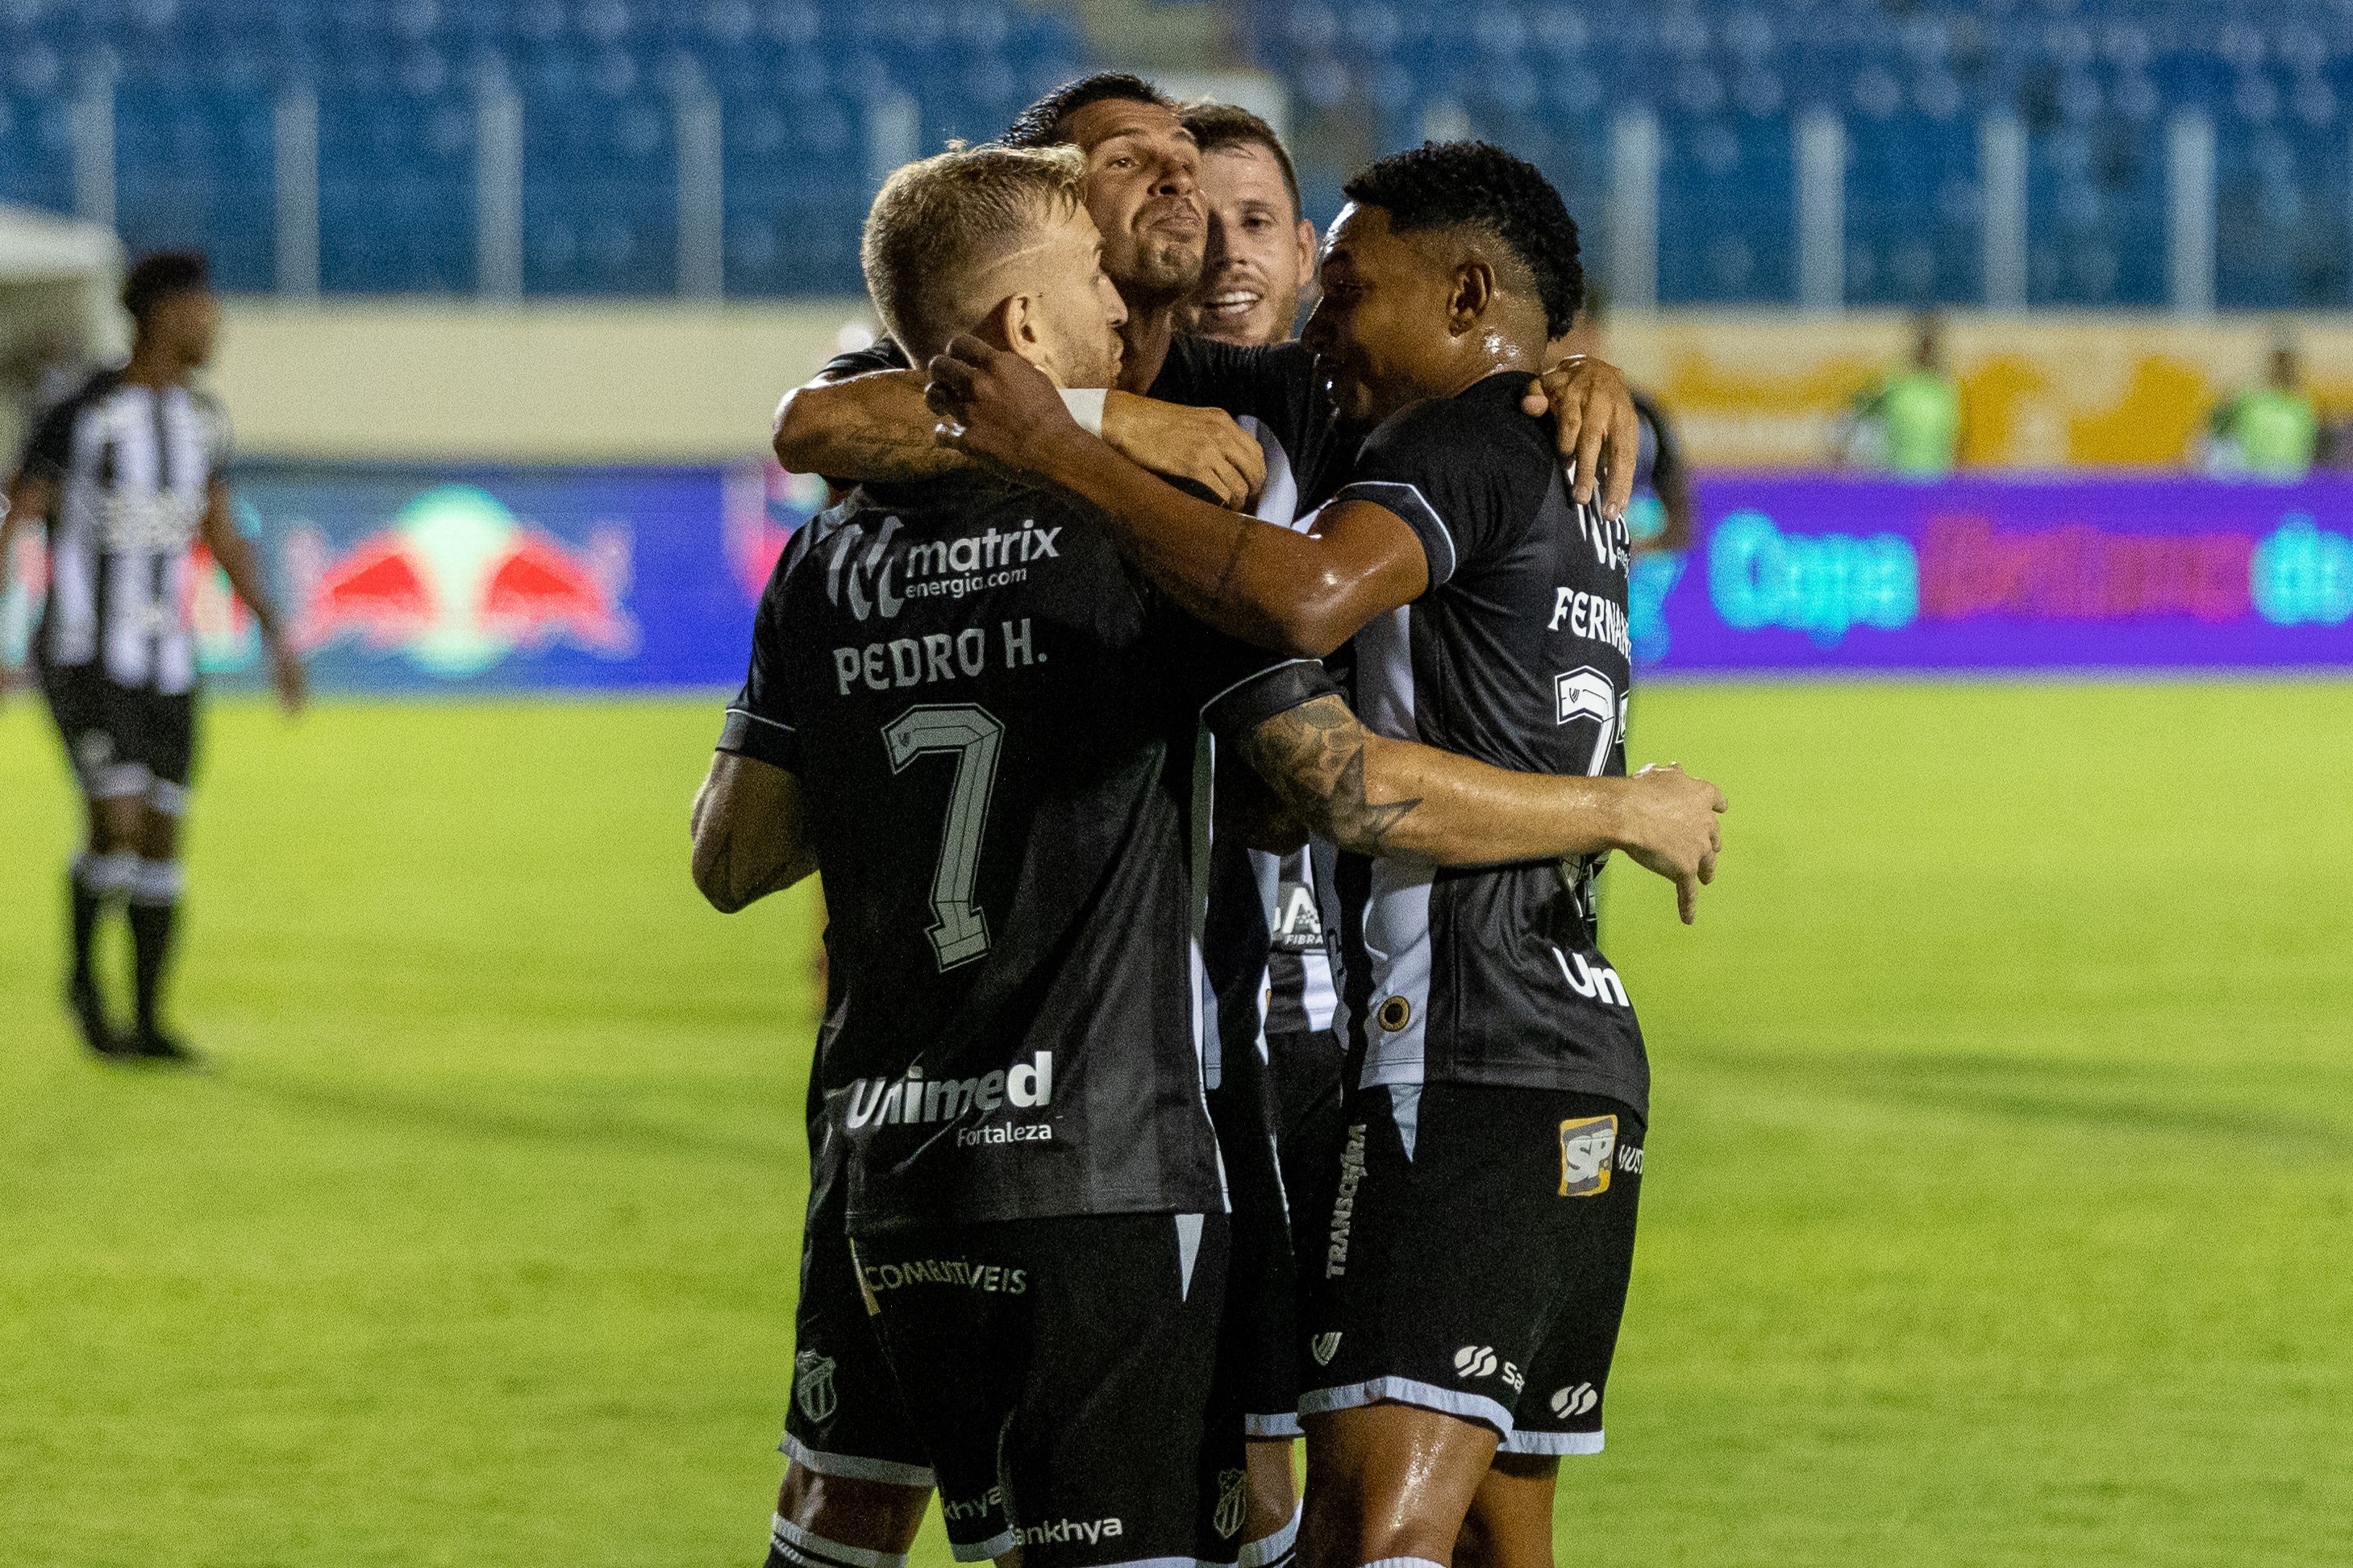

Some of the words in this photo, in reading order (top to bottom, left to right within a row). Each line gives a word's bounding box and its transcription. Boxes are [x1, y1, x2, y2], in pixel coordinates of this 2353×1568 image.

[905, 566, 1028, 599] energia.com
[906, 519, 1063, 579] matrix
[833, 627, 985, 696] PEDRO
[1002, 618, 1048, 669] H.
[1555, 665, 1629, 776] 7
[881, 702, 1006, 973] 7
[1552, 946, 1630, 1008] Un
[846, 1050, 1052, 1129] Unimed
[956, 1121, 1052, 1147] Fortaleza
